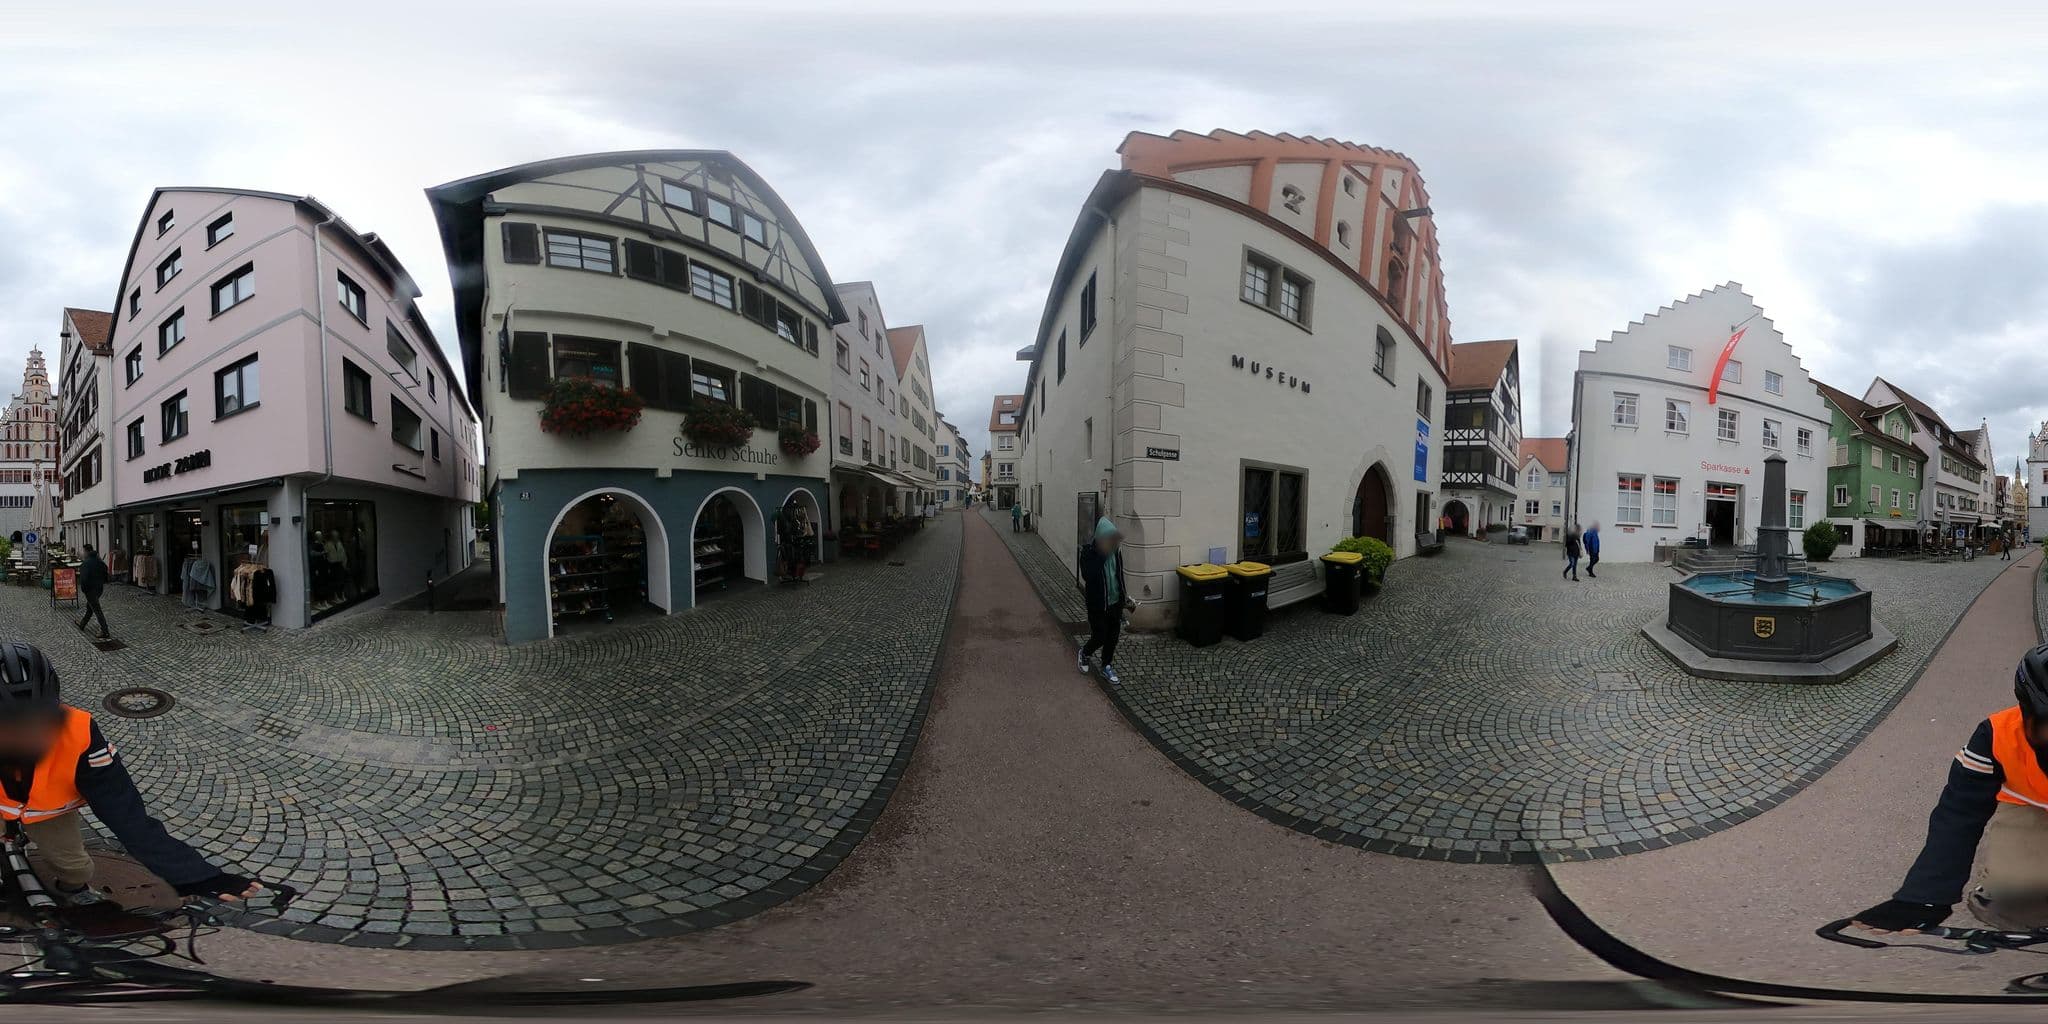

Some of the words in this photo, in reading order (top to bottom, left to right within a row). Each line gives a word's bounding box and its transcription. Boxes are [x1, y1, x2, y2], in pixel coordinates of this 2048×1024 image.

[1231, 354, 1311, 394] MUSEUM
[673, 436, 726, 460] Senko
[731, 445, 778, 465] Schuhe
[1700, 460, 1741, 474] Sparkasse
